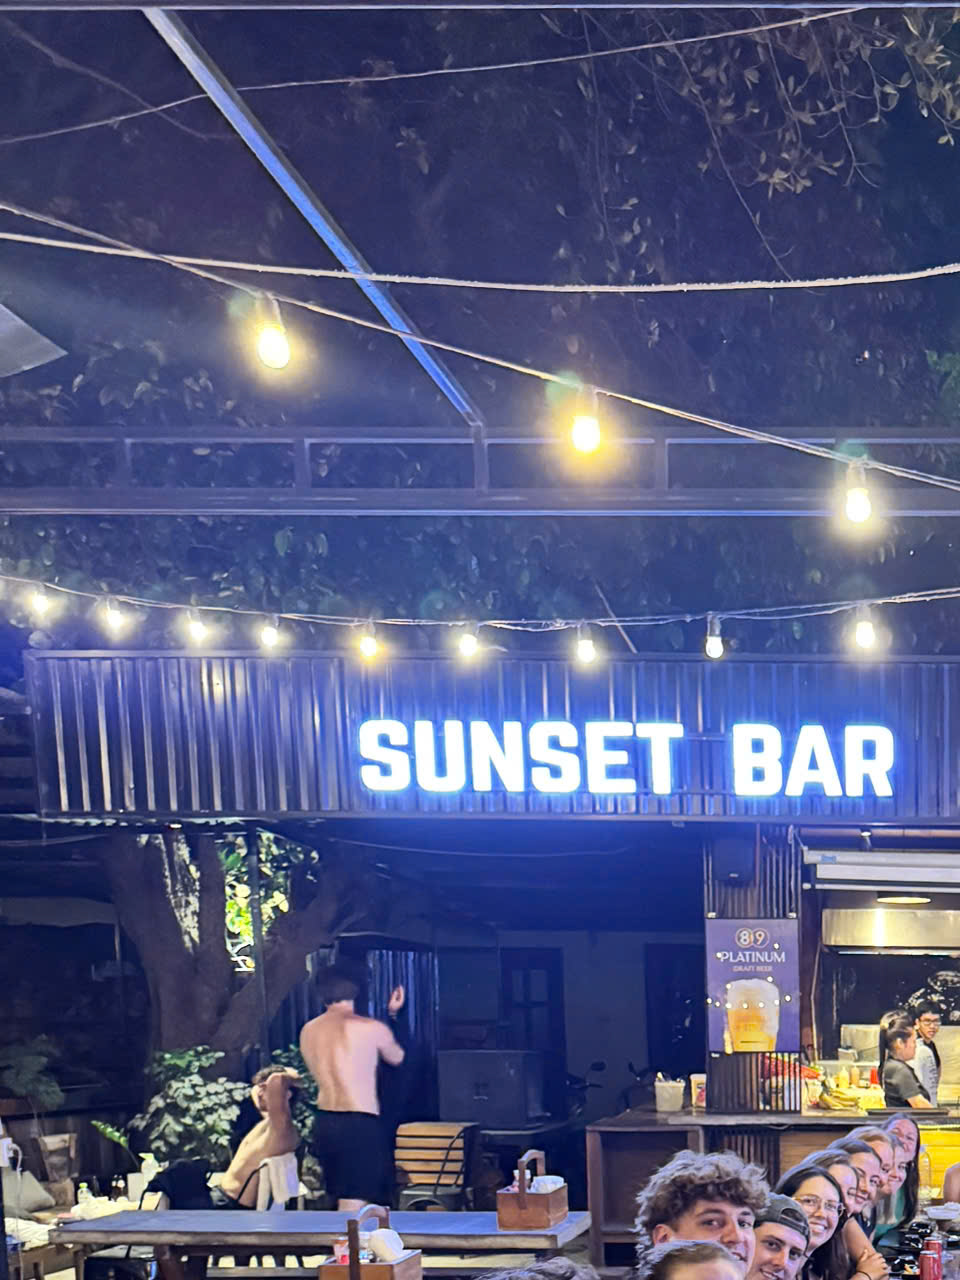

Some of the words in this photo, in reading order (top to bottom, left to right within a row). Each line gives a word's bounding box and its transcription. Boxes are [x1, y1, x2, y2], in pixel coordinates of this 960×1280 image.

[358, 719, 685, 795] SUNSET
[731, 723, 895, 797] BAR
[720, 951, 786, 962] PLATINUM
